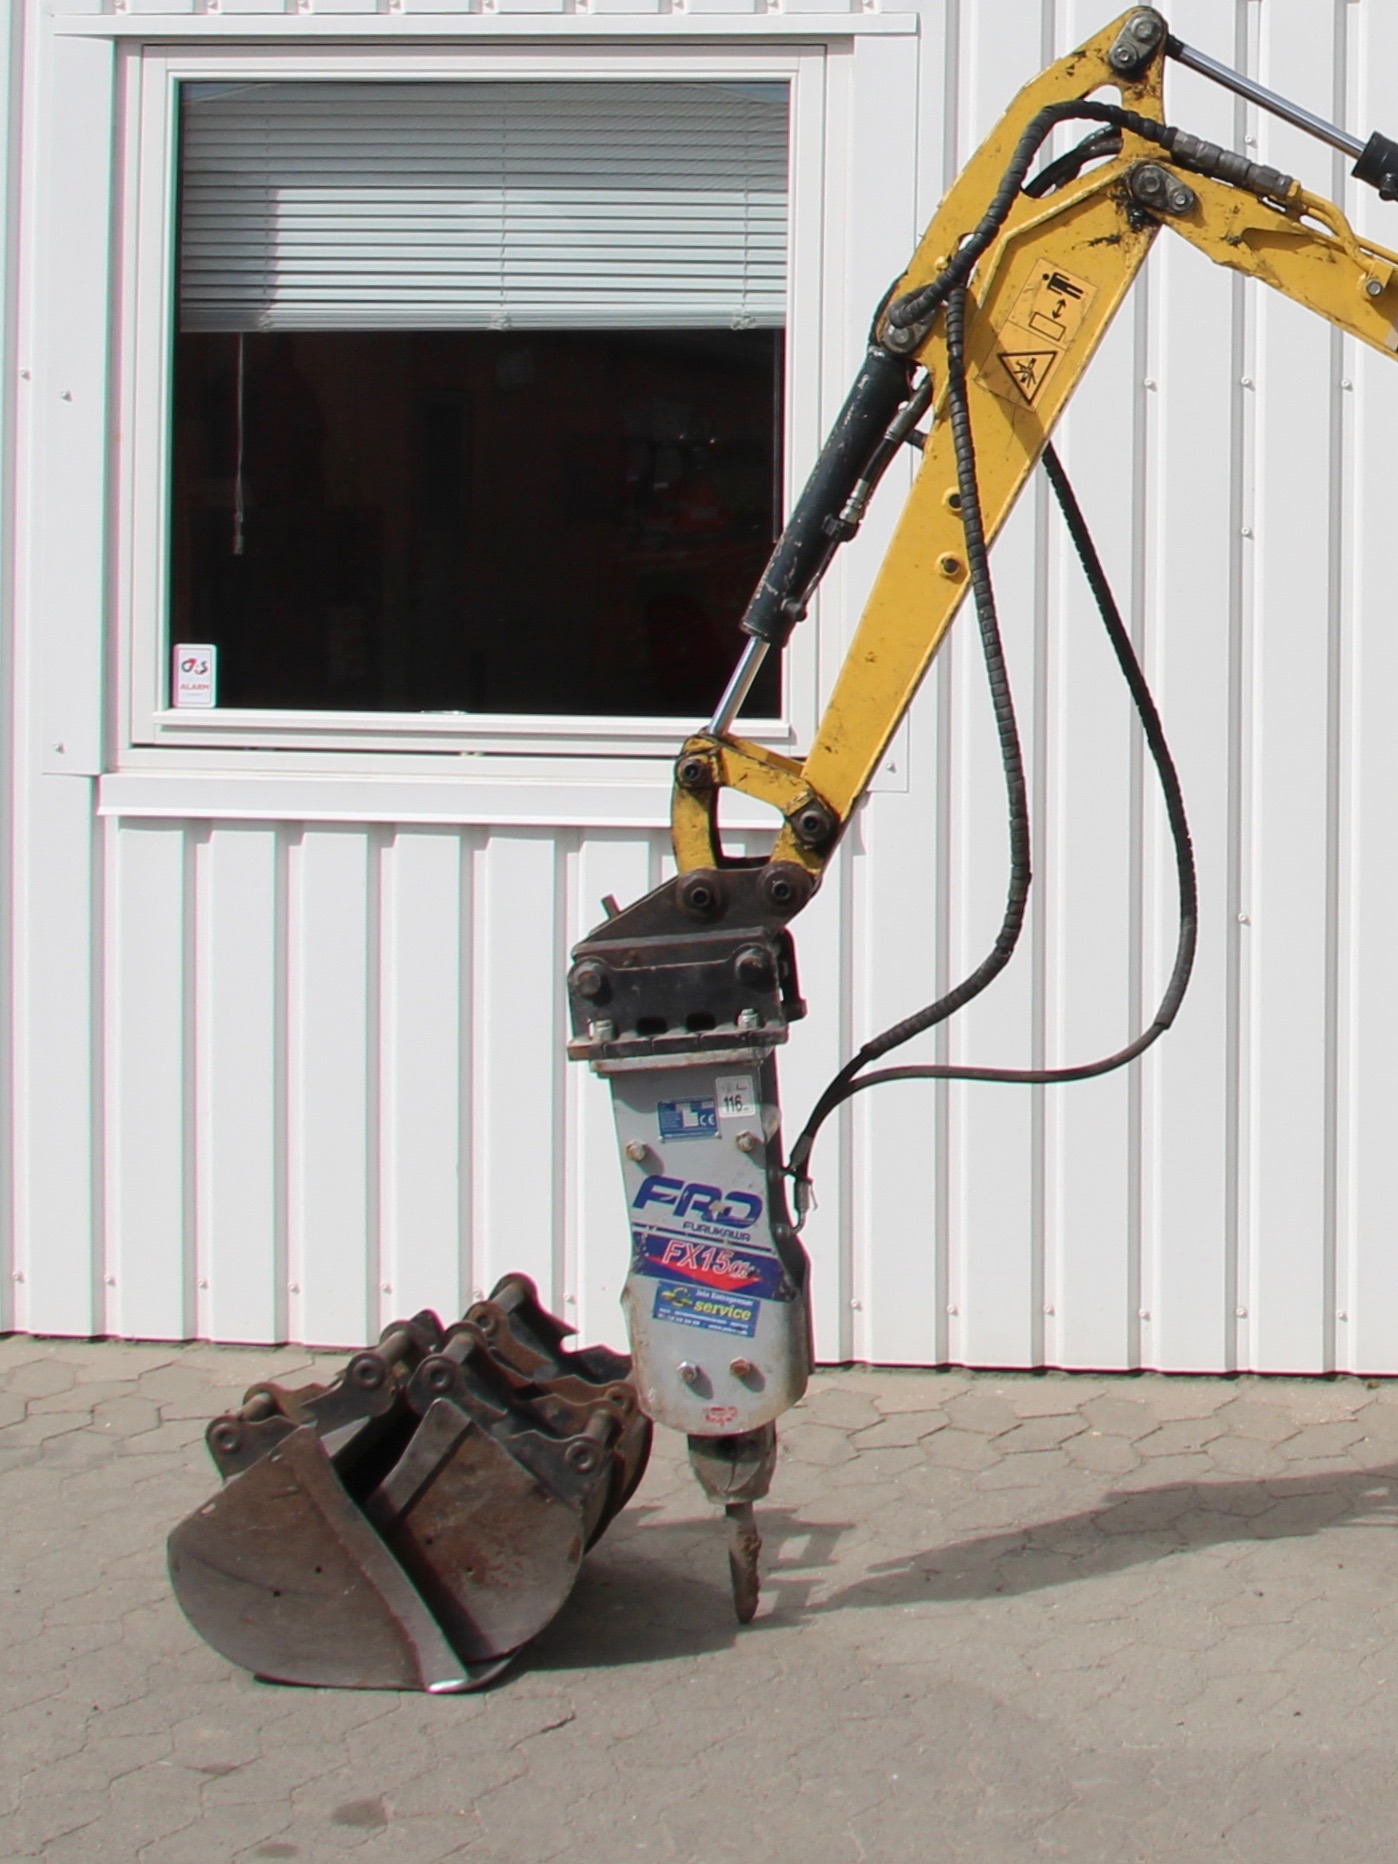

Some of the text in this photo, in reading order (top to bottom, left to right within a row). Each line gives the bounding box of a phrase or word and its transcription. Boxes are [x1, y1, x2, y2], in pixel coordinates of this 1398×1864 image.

[723, 1094, 743, 1113] 116
[682, 1221, 751, 1242] FURUKAWA
[693, 1299, 752, 1321] service
